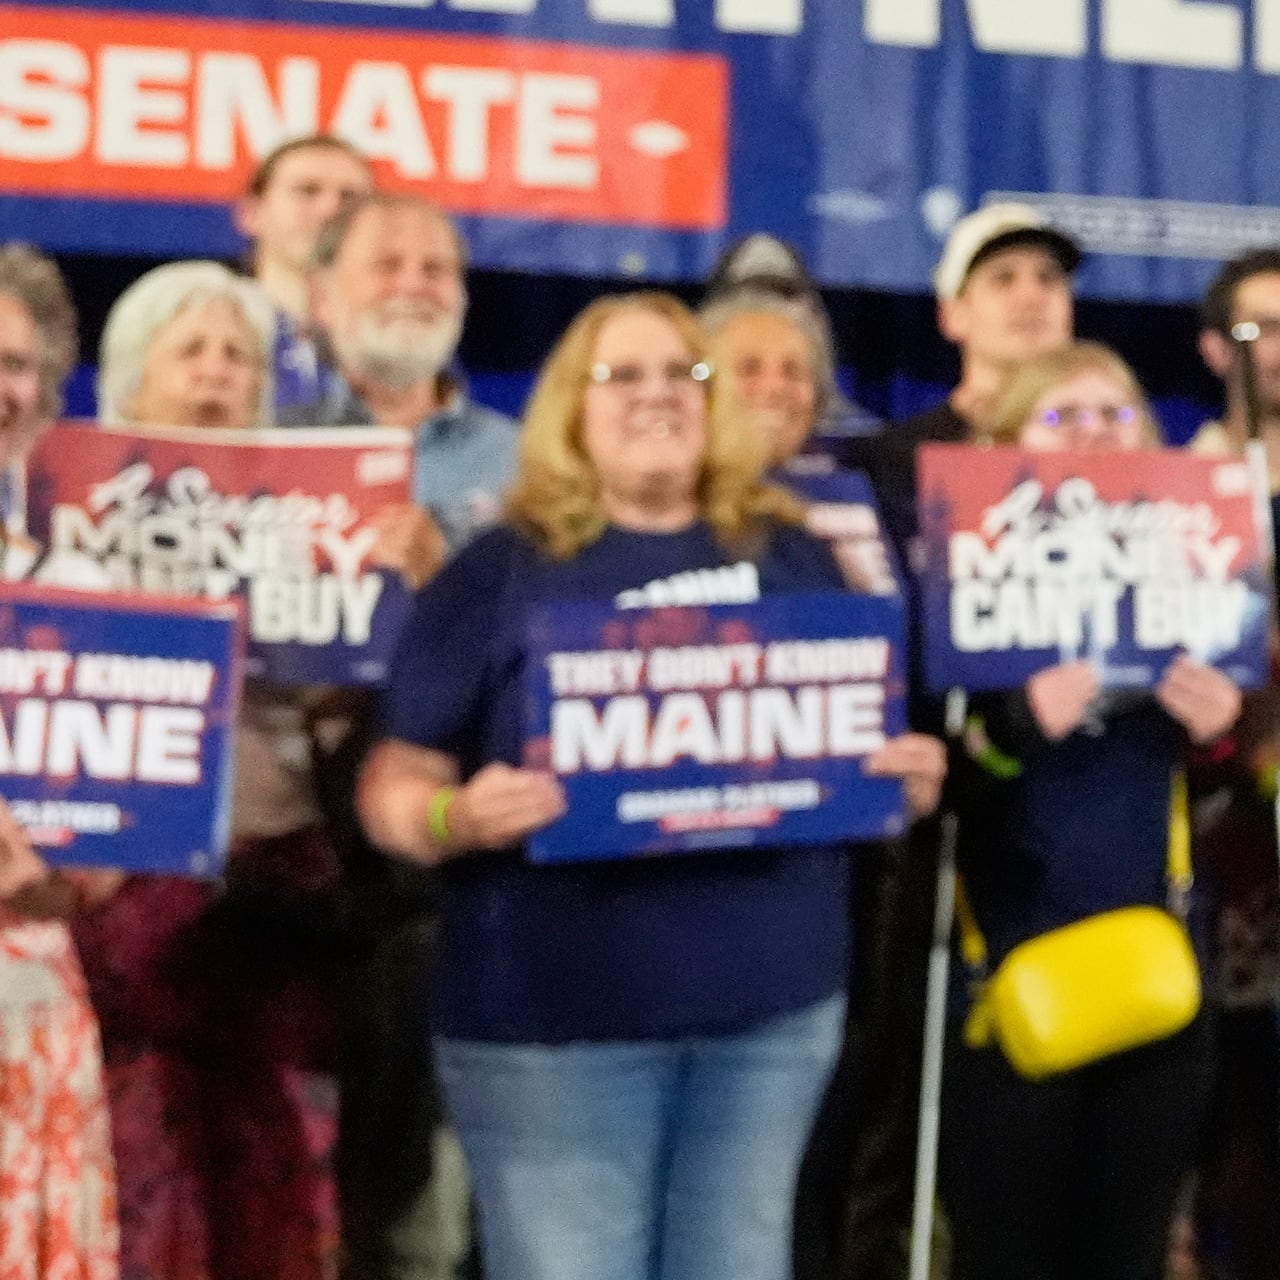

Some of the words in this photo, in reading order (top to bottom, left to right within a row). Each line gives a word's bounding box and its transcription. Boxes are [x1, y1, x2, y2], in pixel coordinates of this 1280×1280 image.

[0, 37, 600, 187] SENATE
[52, 504, 378, 580] MONEY
[950, 531, 1243, 587] MONEY
[250, 573, 384, 647] BUY
[549, 681, 887, 774] MAINE
